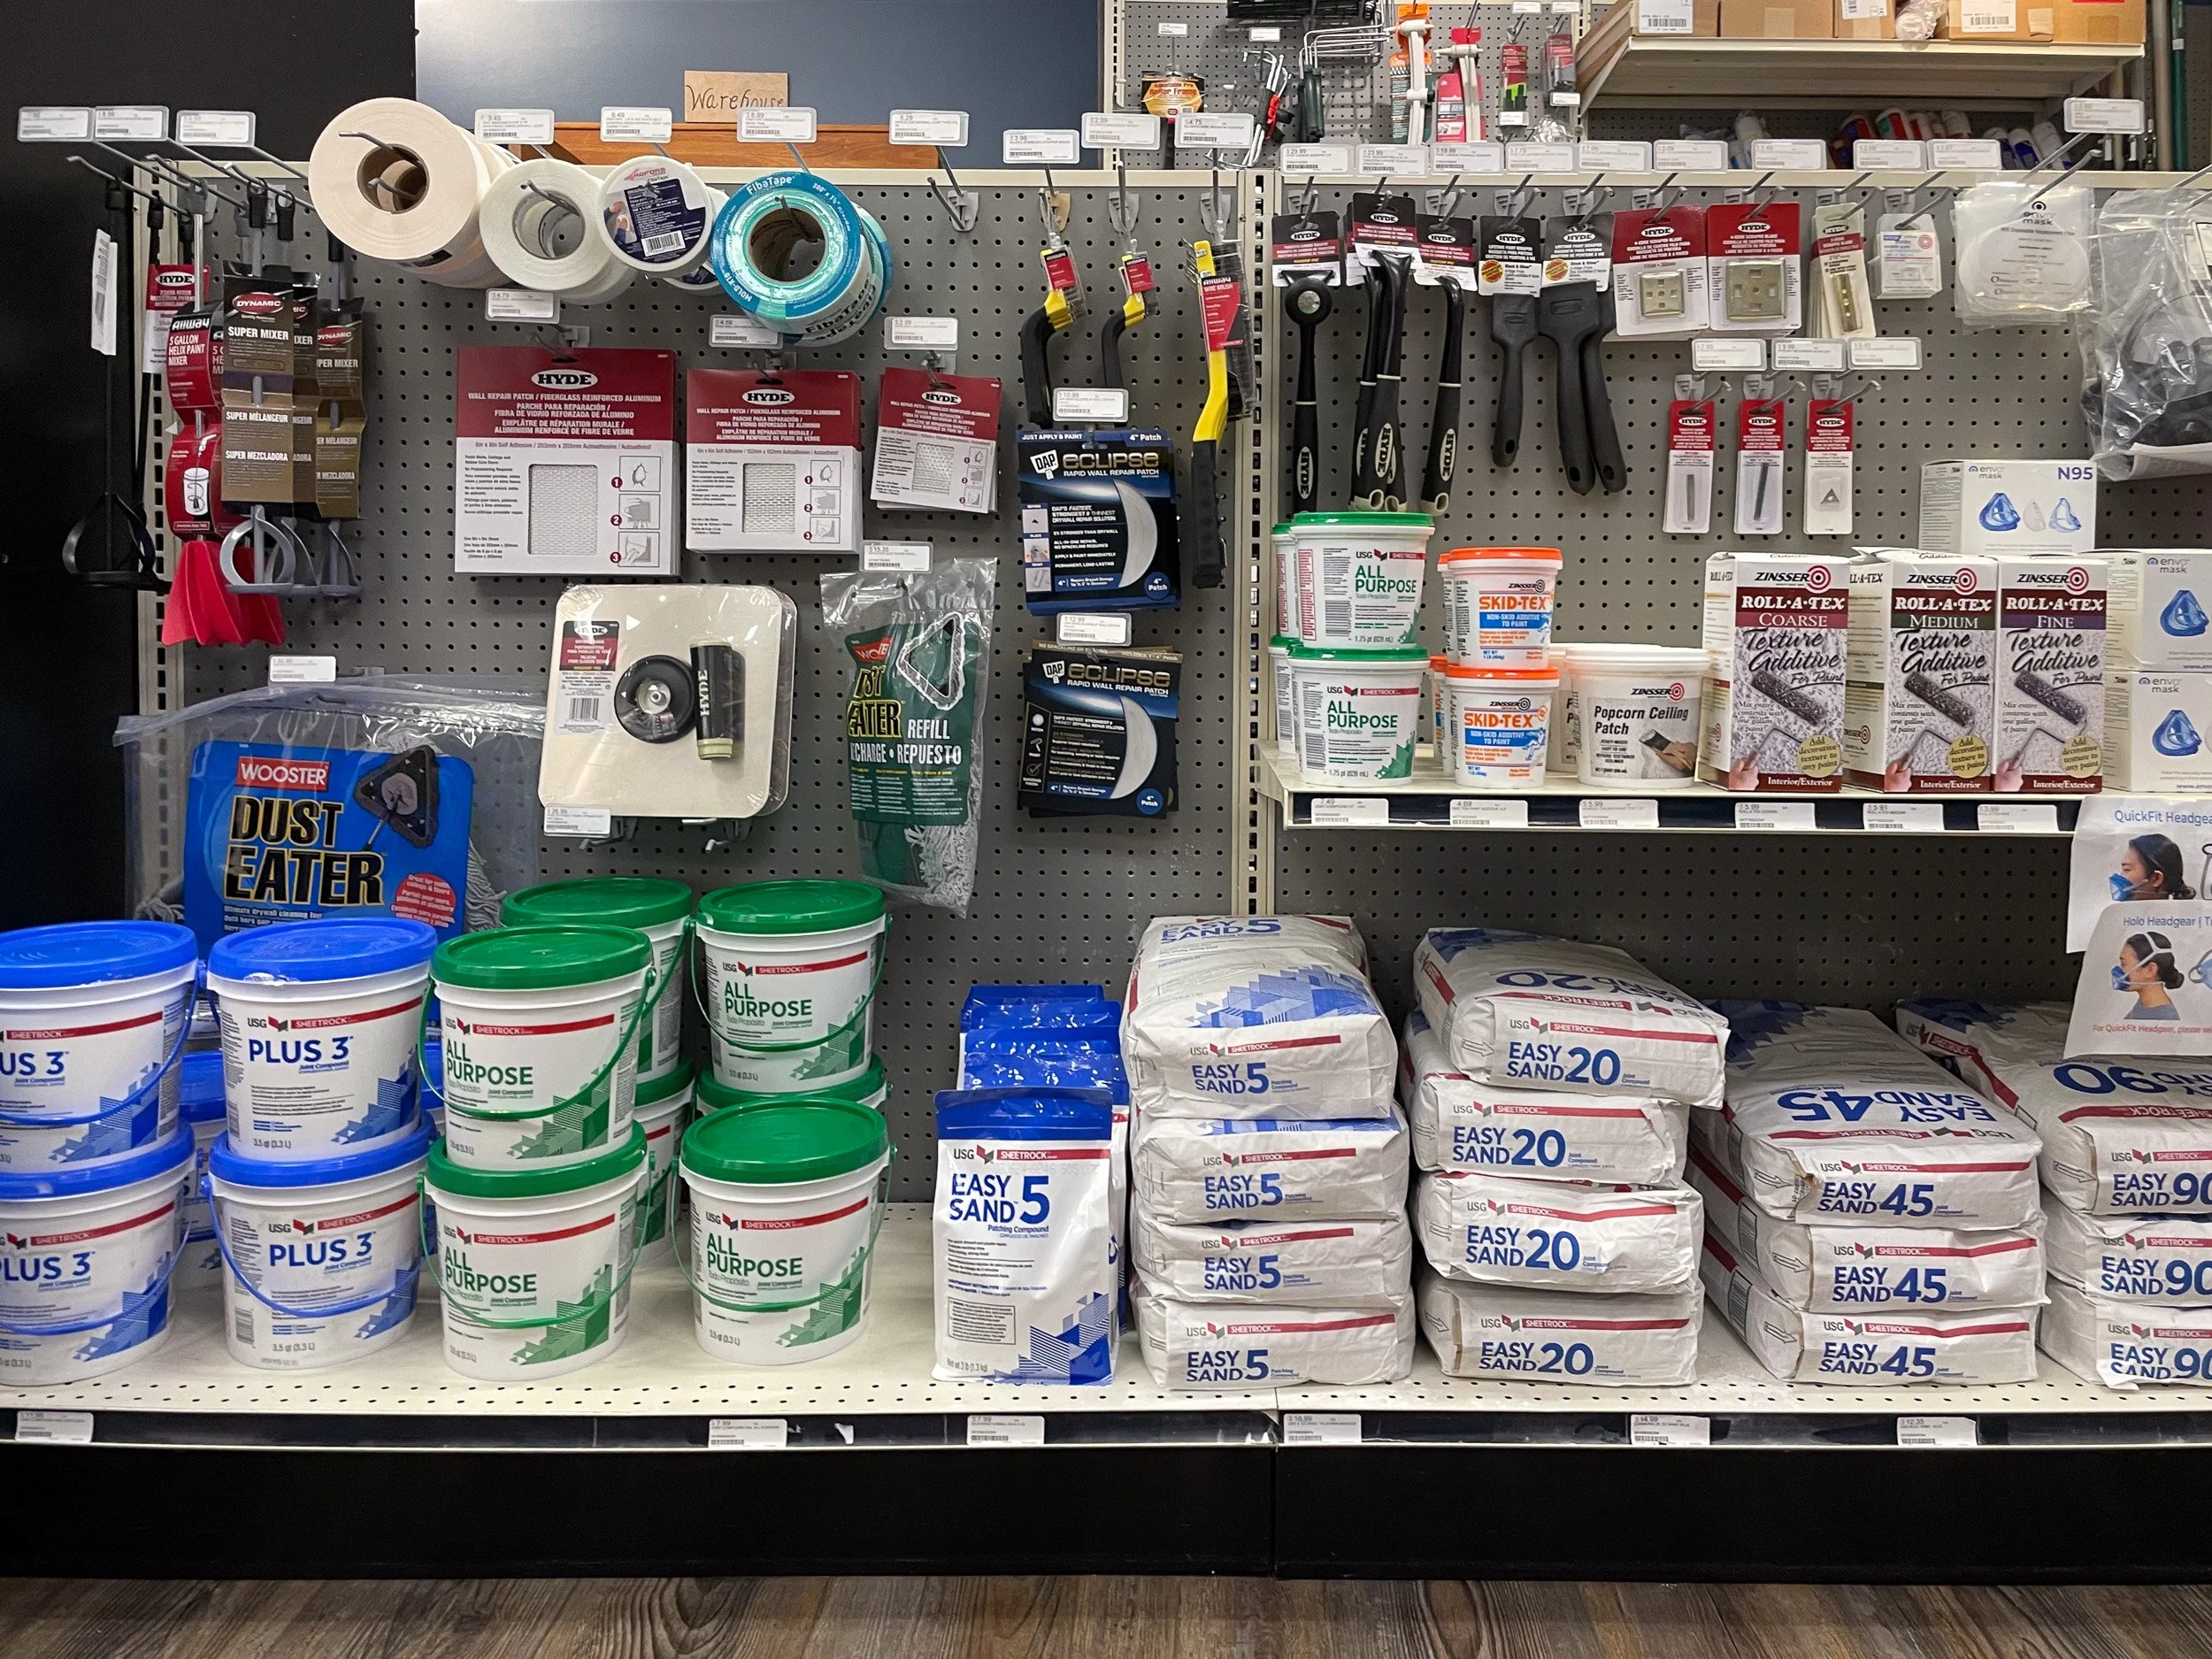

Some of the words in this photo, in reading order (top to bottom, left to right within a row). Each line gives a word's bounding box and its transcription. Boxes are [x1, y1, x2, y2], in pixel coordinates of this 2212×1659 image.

[746, 175, 793, 196] FibaTape
[1431, 234, 1454, 242] HYDE
[1567, 233, 1593, 242] HYDE
[158, 274, 193, 284] HYDE
[174, 334, 199, 345] GALLON
[227, 326, 257, 338] SUPER
[260, 328, 288, 341] MIXER
[169, 346, 187, 356] HELIX
[187, 344, 205, 354] PAINT
[168, 356, 188, 366] MIXER
[537, 374, 591, 385] HYDE
[747, 393, 790, 403] HYDE
[926, 394, 958, 404] HYDE
[227, 411, 248, 421] SUPER
[226, 450, 246, 460] SUPER
[1378, 427, 1391, 472] HYDE
[1442, 434, 1454, 476] HYDE
[1035, 454, 1057, 470] DAP
[1301, 451, 1310, 495] HYDE
[2057, 466, 2093, 480] N95
[1356, 565, 1385, 579] ALL
[1755, 572, 1810, 582] ZINSSER
[1907, 574, 1958, 584] ZINSSER
[2017, 574, 2069, 584] ZINSSER
[1356, 580, 1417, 593] PURPOSE
[1759, 612, 1827, 626] COARSE
[1909, 614, 1978, 628] MEDIUM
[2037, 615, 2074, 628] FINE
[1743, 627, 1824, 650] Texture
[1895, 629, 1971, 651] Texture
[2006, 629, 2084, 651] Texture
[1749, 649, 1841, 672] Additive
[1901, 650, 1986, 673] Additive
[2011, 650, 2099, 673] Additive
[1047, 664, 1064, 676] DAP
[697, 670, 710, 717] HYDE
[1144, 687, 1169, 695] PATCH
[1327, 686, 1342, 695] USG
[1327, 701, 1356, 714] ALL
[1594, 706, 1645, 721] Popcorn
[1649, 707, 1688, 721] Ceiling
[907, 718, 950, 741] REFILL
[1328, 715, 1398, 728] PURPOSE
[1595, 721, 1629, 735] Patch
[896, 743, 962, 765] REPUESTO
[241, 763, 327, 786] WOOSTER
[229, 795, 344, 848] DUST
[2114, 810, 2163, 823] QuickFit
[224, 844, 386, 907] EATER
[2147, 917, 2196, 928] Headgear
[725, 980, 755, 999] ALL
[725, 999, 812, 1018] PURPOSE
[296, 1018, 348, 1028] SHEETROCK
[249, 1039, 322, 1064] PLUS
[332, 1036, 349, 1060] 3
[447, 1039, 472, 1063] ALL
[1506, 1062, 1564, 1081] SAND
[1509, 1041, 1562, 1062] EASY
[1564, 1047, 1621, 1086] 20
[447, 1058, 533, 1086] PURPOSE
[1192, 1064, 1240, 1079] EASY
[1248, 1062, 1270, 1094] 5
[1194, 1079, 1247, 1094] SAND
[954, 1148, 974, 1160] USG
[1001, 1150, 1048, 1159] SHEETROCK
[1204, 1175, 1253, 1192] EASY
[1260, 1173, 1283, 1206] 5
[2113, 1173, 2168, 1191] EASY
[951, 1173, 1012, 1198] EASY
[1019, 1175, 1051, 1225] 5
[1205, 1194, 1259, 1209] SAND
[1816, 1199, 1878, 1214] SAND
[1822, 1182, 1877, 1200] EASY
[1878, 1183, 1934, 1217] 45
[2110, 1193, 2170, 1207] SAND
[949, 1198, 1016, 1223] SAND
[987, 1225, 1013, 1233] Patching
[270, 1240, 347, 1267] PLUS
[357, 1232, 373, 1256] 3
[707, 1233, 739, 1256] ALL
[1467, 1225, 1520, 1246] EASY
[1525, 1229, 1580, 1271] 20
[1834, 1246, 1855, 1256] USG
[1878, 1247, 1921, 1256] SHEETROCK
[444, 1246, 472, 1271] ALL
[708, 1251, 803, 1278] PURPOSE
[1465, 1246, 1523, 1267] SAND
[1204, 1256, 1253, 1272] EASY
[1258, 1255, 1281, 1288] 5
[2101, 1256, 2159, 1276] EASY
[445, 1264, 537, 1294] PURPOSE
[1203, 1274, 1257, 1290] SAND
[1834, 1266, 1888, 1285] EASY
[1892, 1268, 1947, 1303] 45
[2101, 1274, 2163, 1295] SAND
[1832, 1286, 1891, 1303] SAND
[1187, 1326, 1207, 1336] USG
[1231, 1324, 1273, 1333] SHEETROCK
[1481, 1318, 1502, 1328] USG
[1481, 1342, 1534, 1358] EASY
[1538, 1342, 1594, 1375] 20
[2110, 1342, 2168, 1364] EASY
[1187, 1350, 1240, 1368] EASY
[1245, 1349, 1269, 1380] 5
[1479, 1358, 1537, 1371] SAND
[1186, 1368, 1243, 1382] SAND
